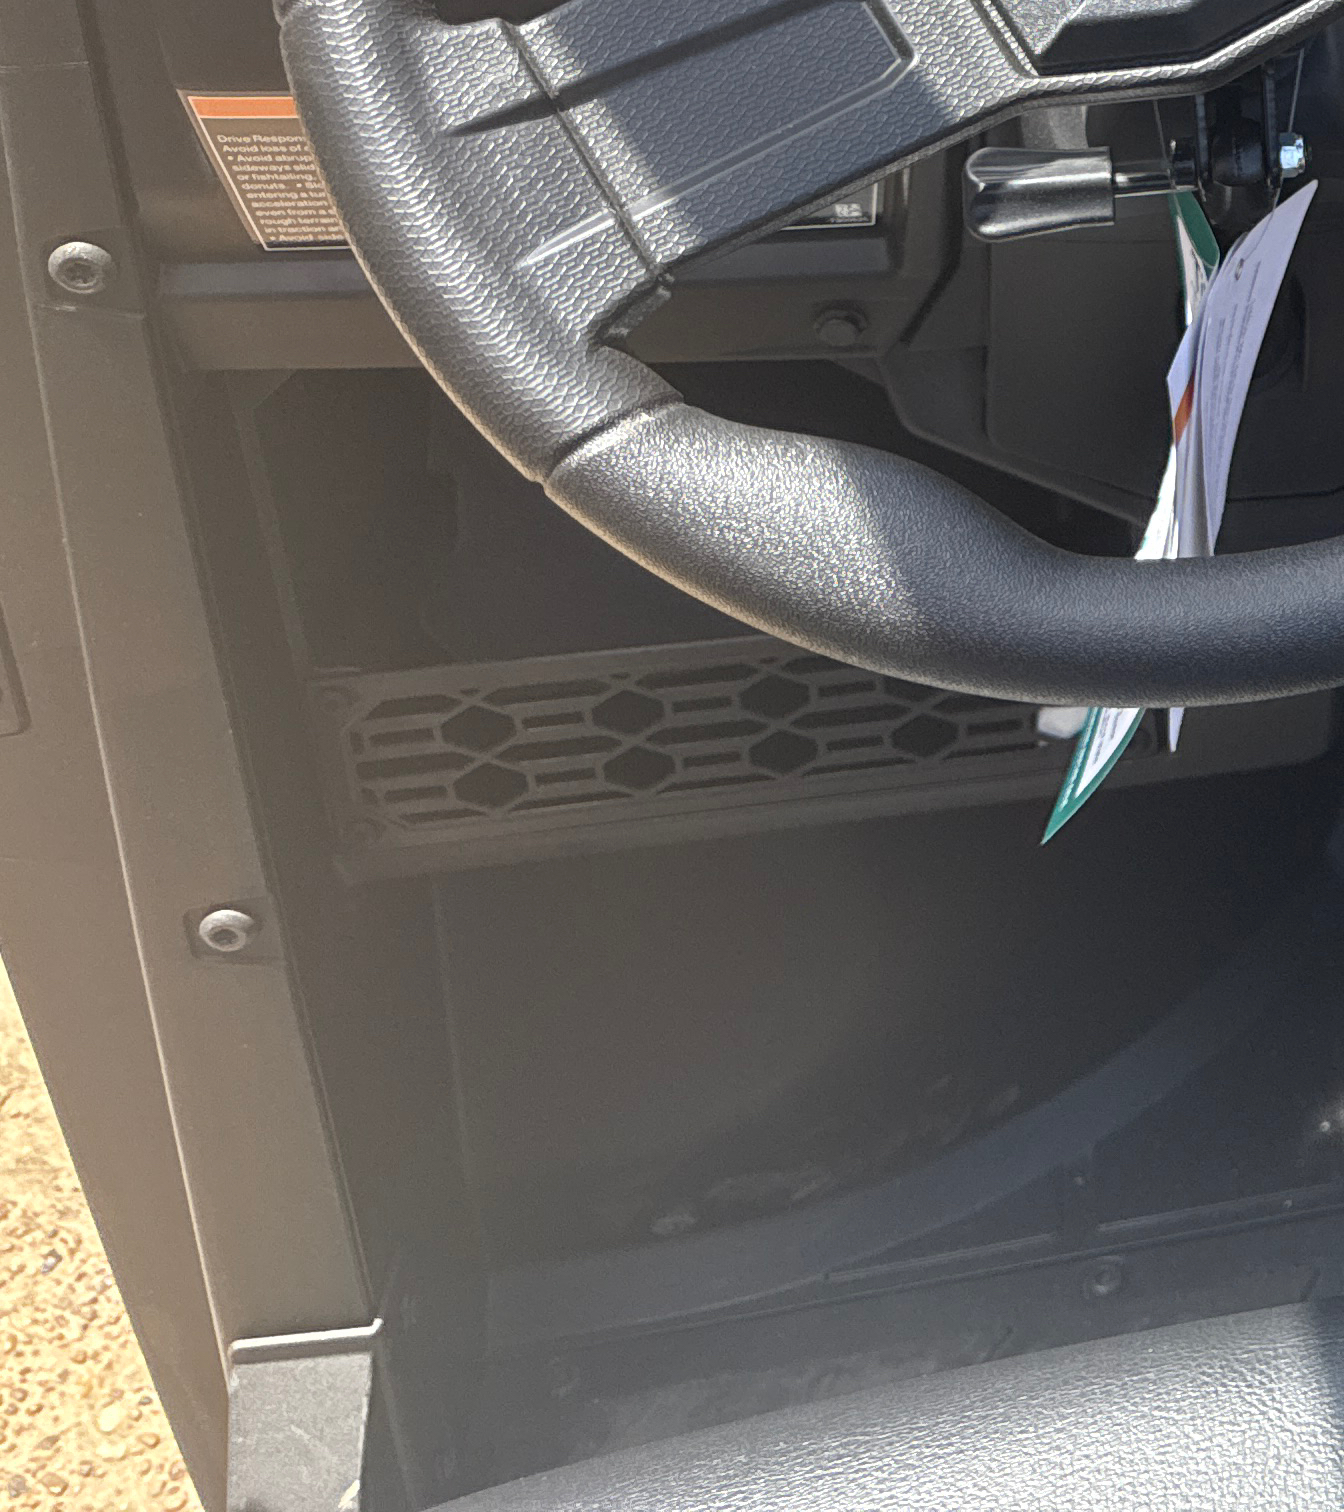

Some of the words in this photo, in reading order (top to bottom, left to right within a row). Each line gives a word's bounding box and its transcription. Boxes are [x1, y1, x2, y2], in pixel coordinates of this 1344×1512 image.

[217, 134, 251, 143] Drive
[222, 144, 259, 153] Avoid
[260, 144, 288, 153] loss
[288, 144, 302, 153] of
[237, 154, 273, 162] Avoid
[231, 164, 292, 172] sideways
[246, 191, 299, 200] entering
[251, 200, 328, 208] acceleration
[255, 209, 286, 217] even
[287, 208, 316, 216] from
[259, 218, 296, 226] rough
[277, 225, 327, 233] traction
